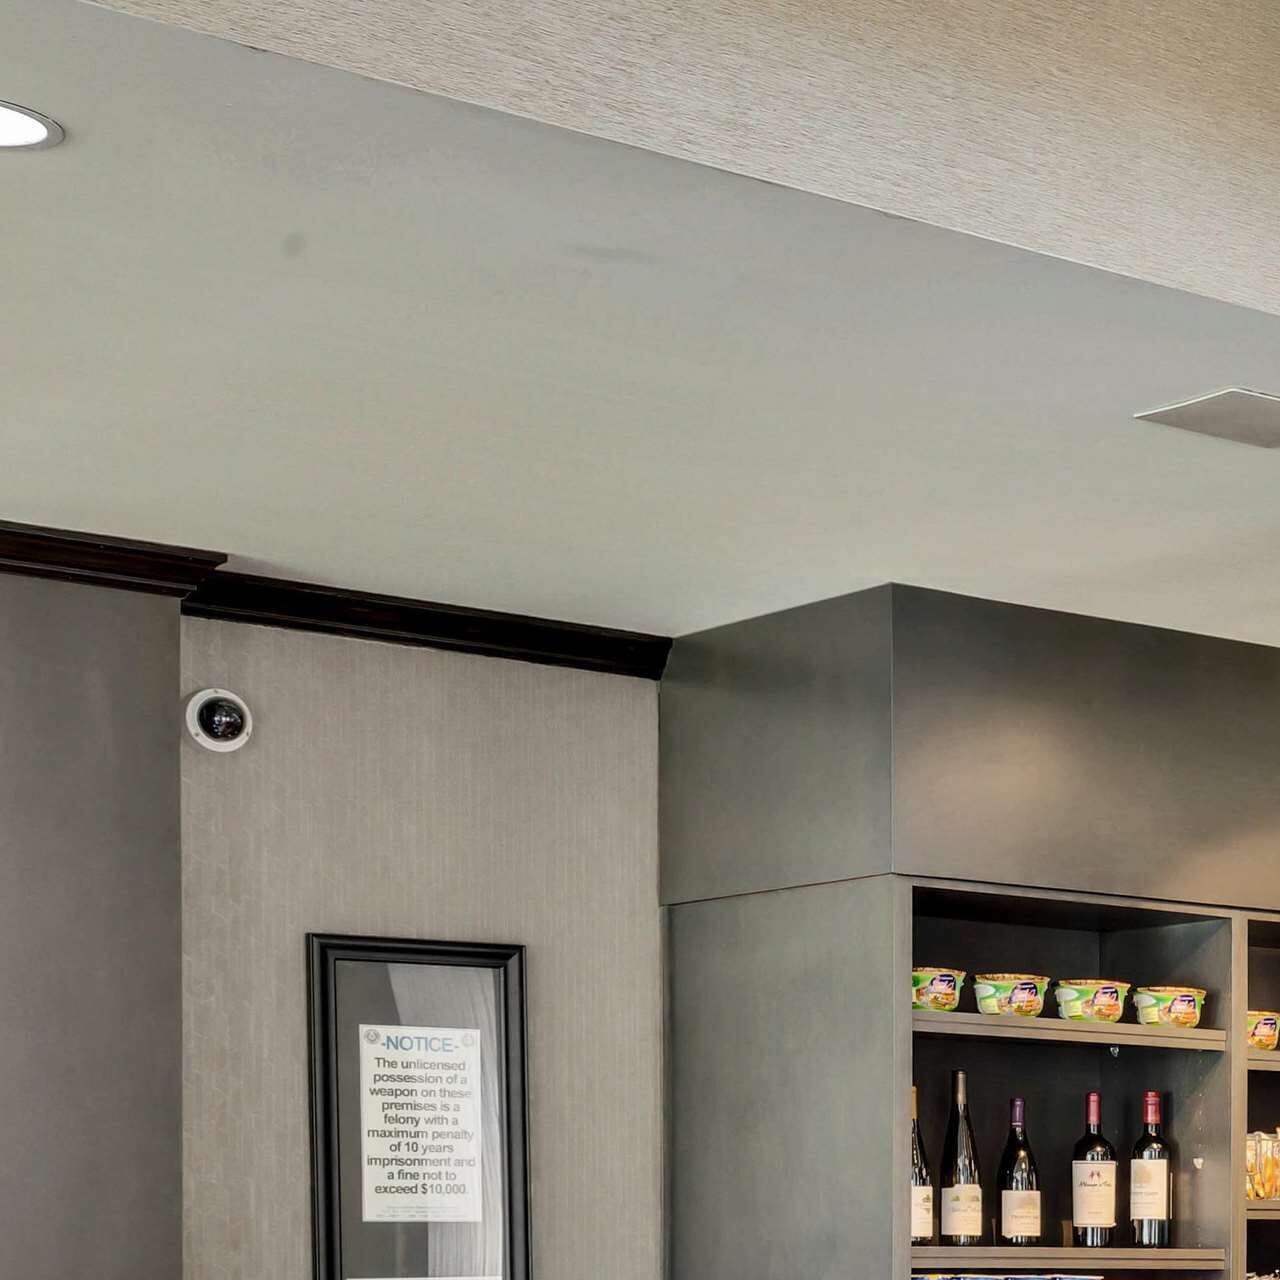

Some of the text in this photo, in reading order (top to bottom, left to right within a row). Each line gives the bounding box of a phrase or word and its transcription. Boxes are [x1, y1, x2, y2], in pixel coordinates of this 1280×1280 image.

[374, 1057, 466, 1071] The unlicensed
[373, 1073, 468, 1085] possession of a
[369, 1087, 472, 1099] weapon on these
[381, 1100, 460, 1112] premises is a
[384, 1113, 459, 1127] felony with a
[367, 1128, 475, 1142] maximum penalty
[389, 1141, 455, 1155] of 10 years
[367, 1155, 477, 1168] imprisonment and
[386, 1168, 458, 1181] a fine not to
[374, 1183, 418, 1194] exceed
